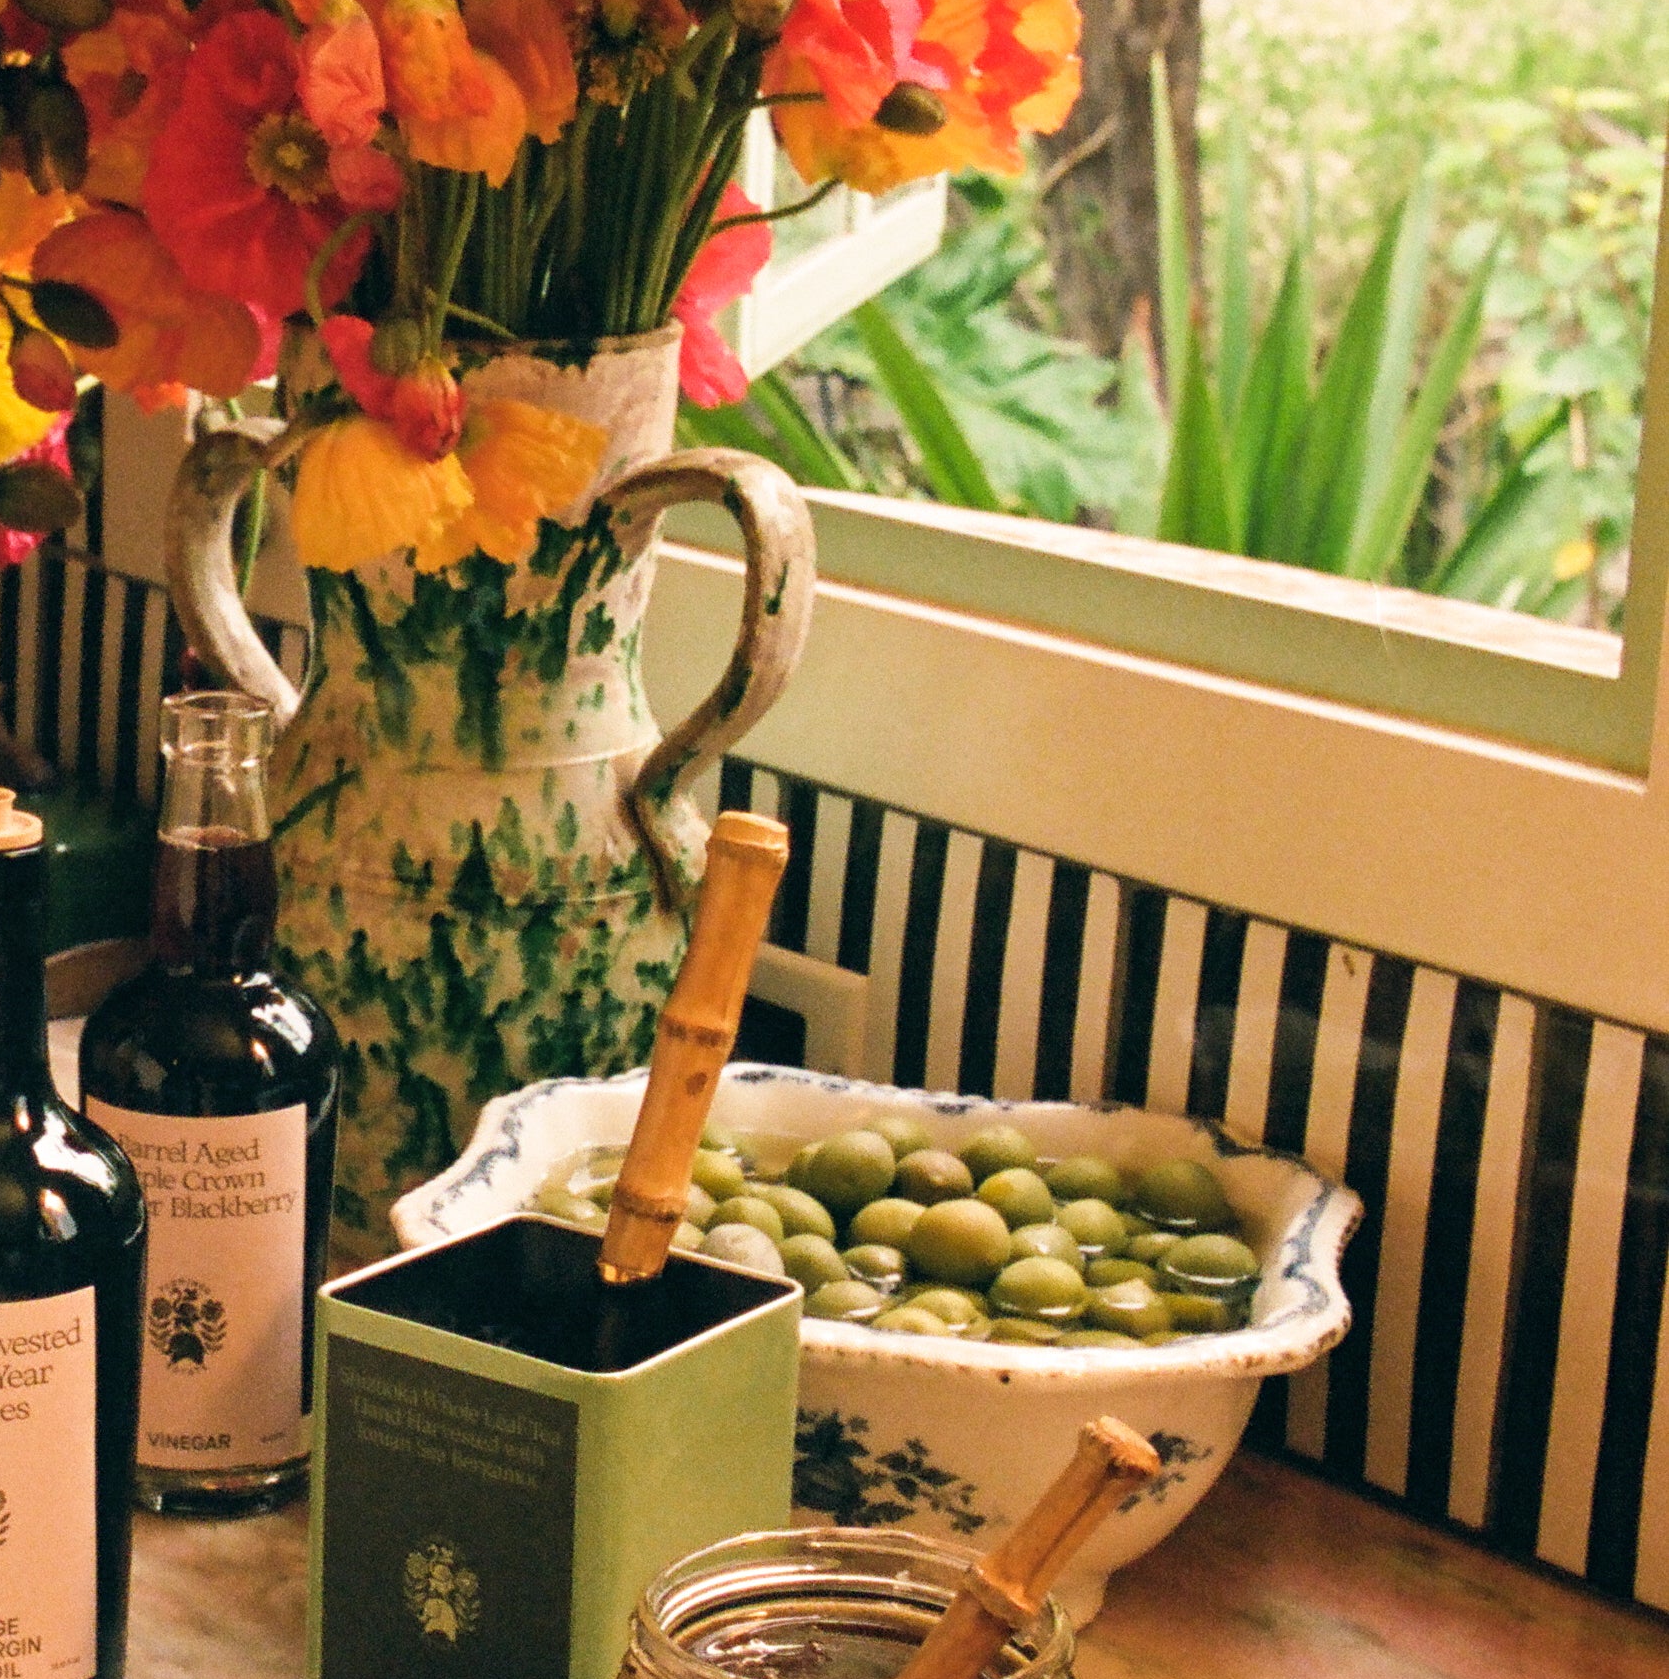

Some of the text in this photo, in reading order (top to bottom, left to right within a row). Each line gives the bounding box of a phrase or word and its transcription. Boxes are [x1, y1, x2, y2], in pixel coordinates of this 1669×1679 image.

[194, 1138, 261, 1168] Aged
[136, 1167, 266, 1193] ple Crown
[171, 1190, 299, 1219] Blackberry
[147, 1432, 231, 1451] VINEGAR
